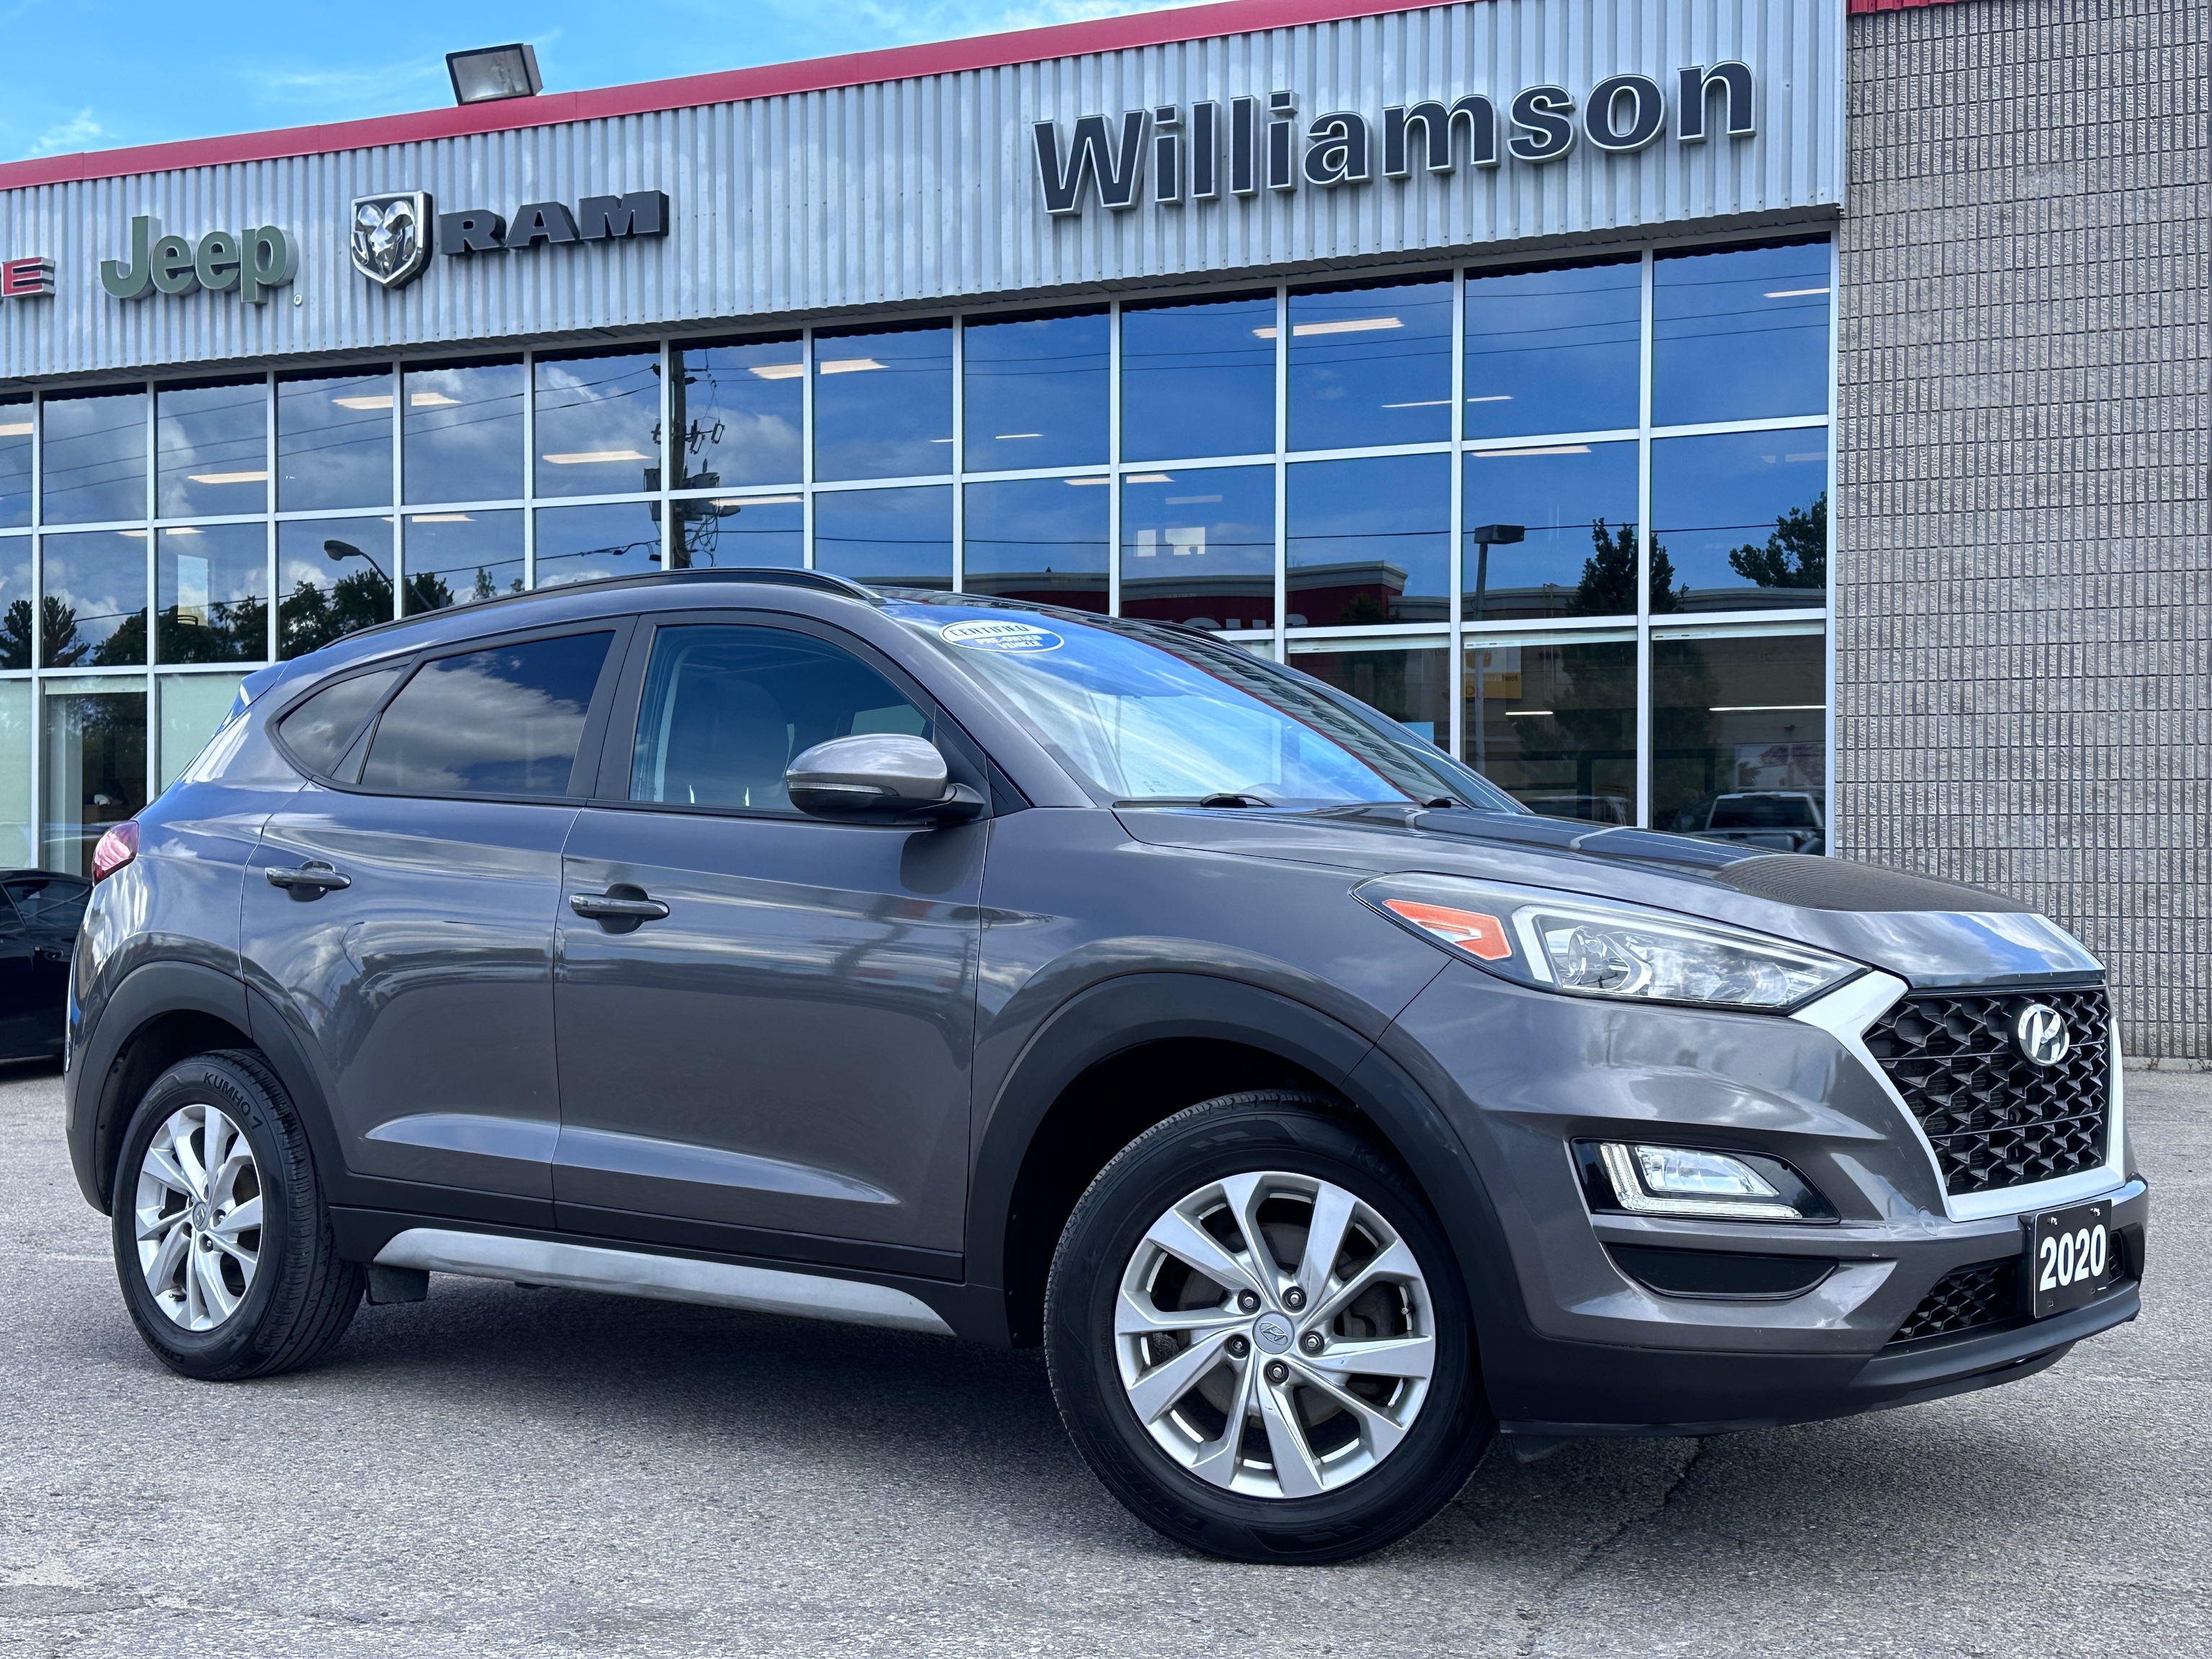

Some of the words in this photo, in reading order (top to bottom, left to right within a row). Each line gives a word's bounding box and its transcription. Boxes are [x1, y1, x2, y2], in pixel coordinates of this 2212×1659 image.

[1032, 60, 1757, 216] Williamson
[440, 190, 669, 256] RAM
[100, 215, 298, 305] Jeep
[203, 1071, 252, 1116] KUMHO
[2039, 1223, 2107, 1292] 2020
